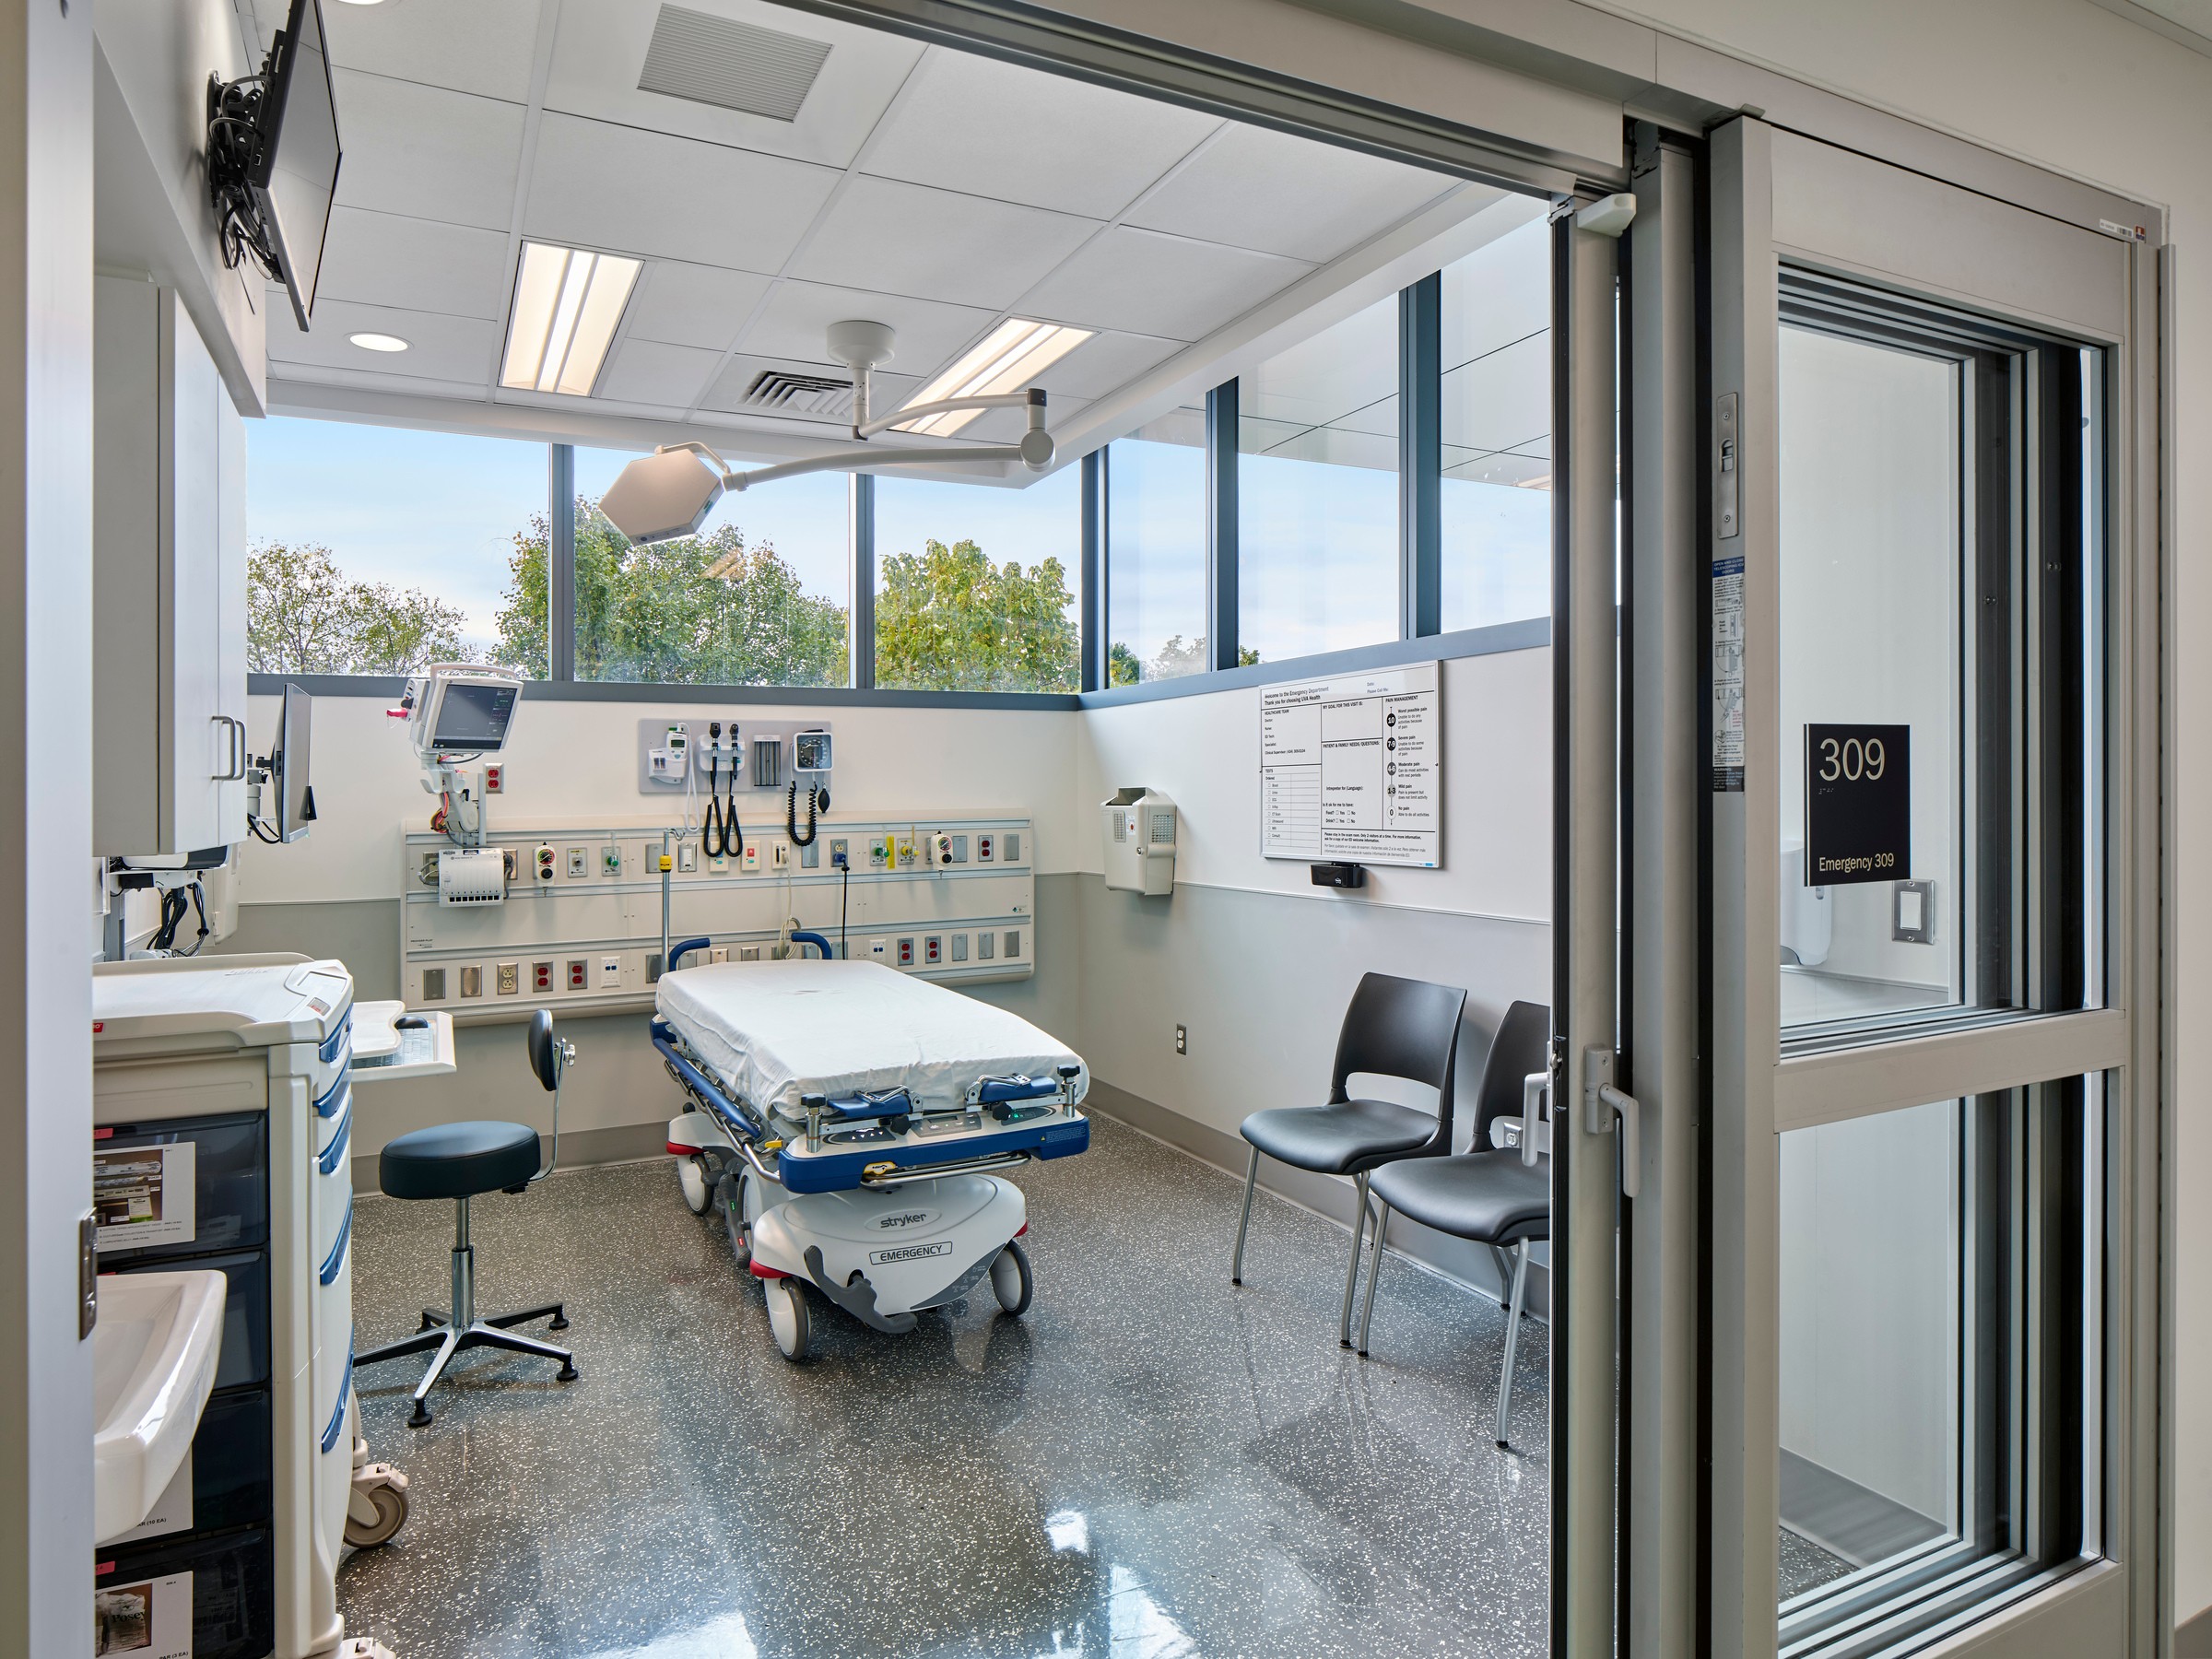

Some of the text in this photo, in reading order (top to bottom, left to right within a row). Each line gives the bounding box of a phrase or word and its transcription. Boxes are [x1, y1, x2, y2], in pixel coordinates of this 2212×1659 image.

[1819, 738, 1885, 781] 309
[1819, 853, 1894, 873] Emergency 309
[881, 1214, 926, 1228] stryker
[880, 1245, 942, 1261] EMERGENCY
[111, 1612, 145, 1622] Posey
